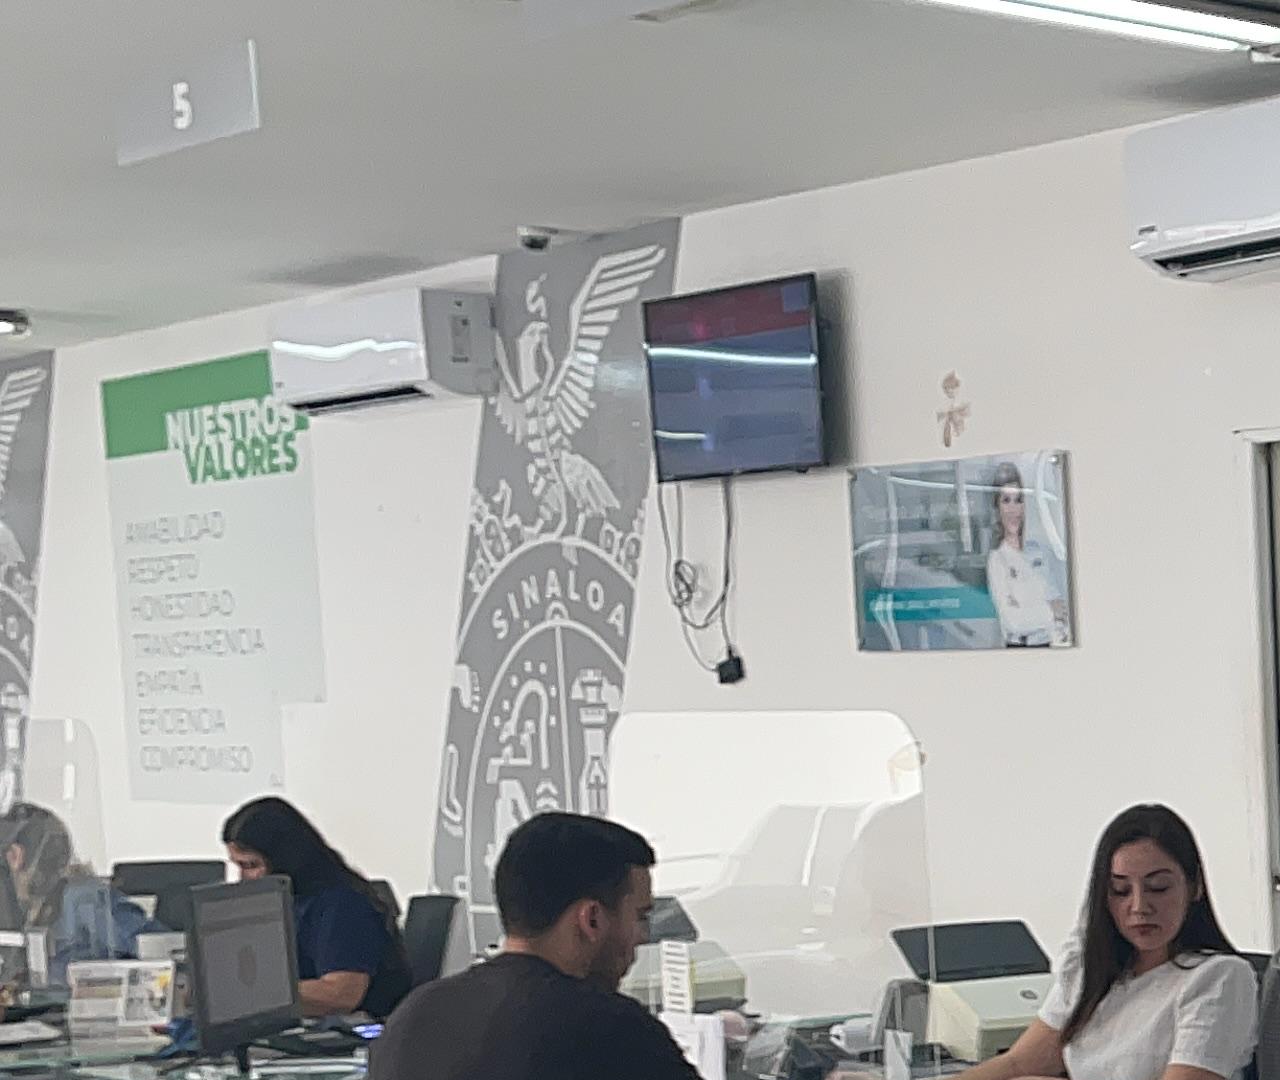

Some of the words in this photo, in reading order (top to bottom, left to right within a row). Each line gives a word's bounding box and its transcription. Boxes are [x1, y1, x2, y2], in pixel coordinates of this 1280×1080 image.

[173, 82, 192, 129] 5
[167, 396, 296, 450] NUESTROS
[184, 431, 298, 484] VALORES
[492, 568, 626, 640] SINALOA
